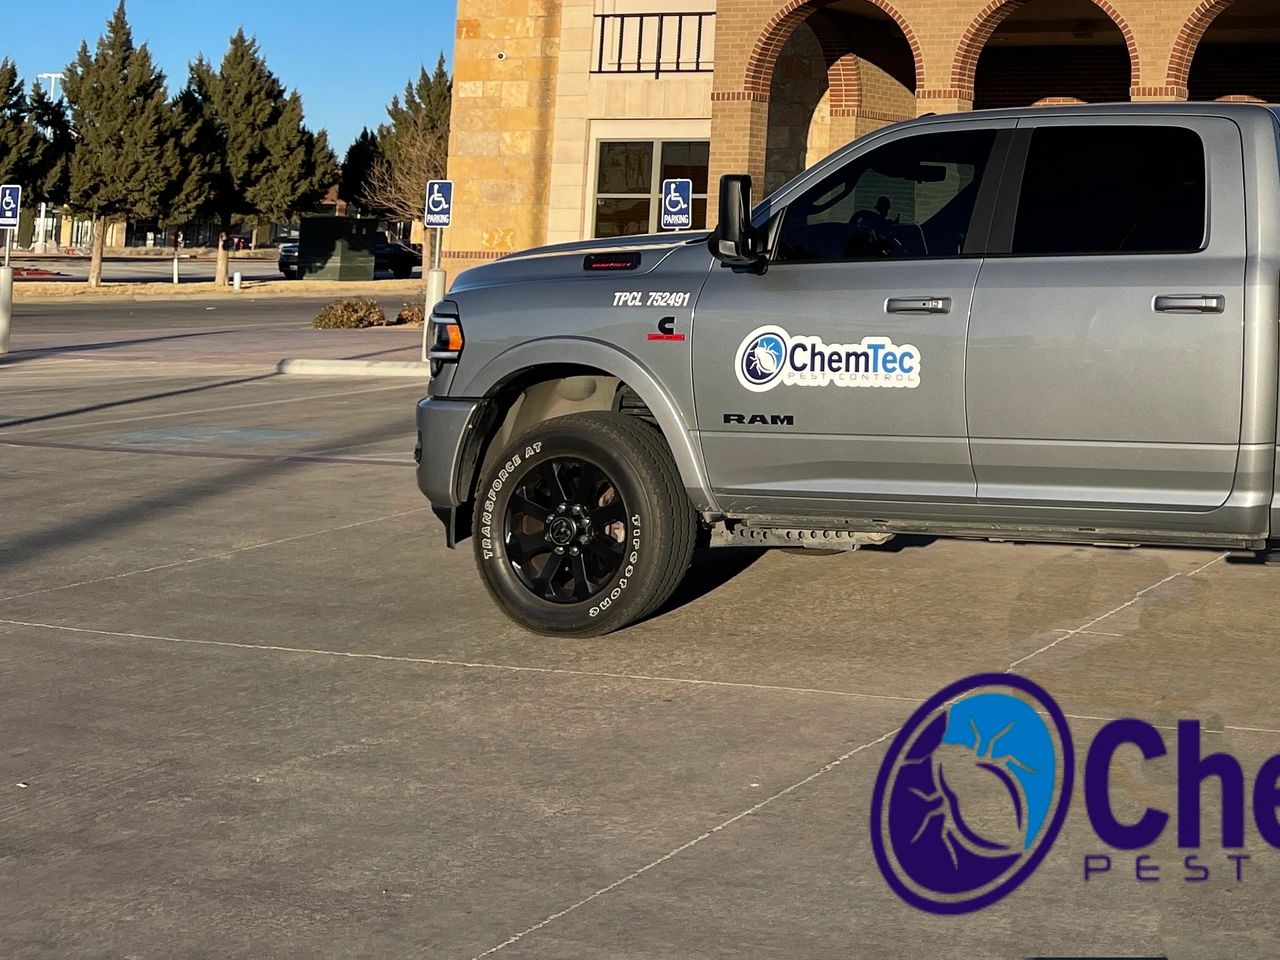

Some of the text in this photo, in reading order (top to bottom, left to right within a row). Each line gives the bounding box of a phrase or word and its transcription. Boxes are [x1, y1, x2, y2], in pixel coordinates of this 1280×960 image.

[426, 214, 449, 224] PARKING
[664, 214, 689, 224] PARKING
[612, 292, 691, 308] TPCL 752491
[789, 342, 915, 374] ChemTec
[788, 372, 915, 382] PEST CONTROL
[723, 413, 794, 426] RAM
[481, 442, 543, 560] TRANSFORCE AT
